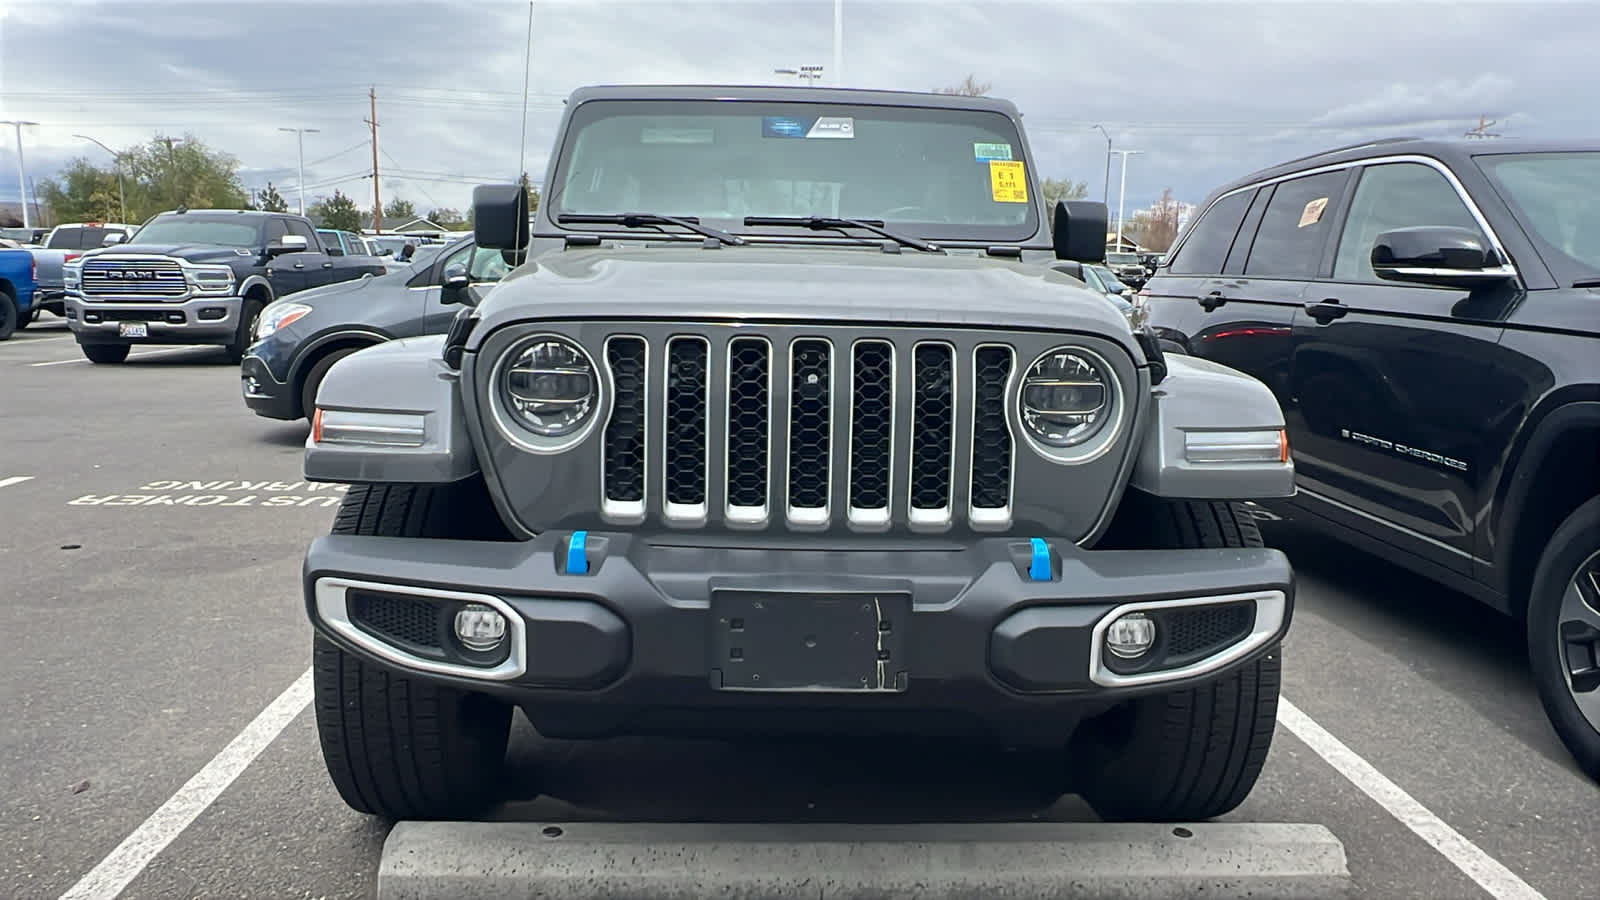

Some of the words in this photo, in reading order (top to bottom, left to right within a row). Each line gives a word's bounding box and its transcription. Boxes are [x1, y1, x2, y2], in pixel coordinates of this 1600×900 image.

[108, 271, 153, 279] RAM
[1351, 432, 1393, 449] GRAND
[1394, 443, 1468, 471] CHEROKEE
[67, 494, 342, 507] USTOMER
